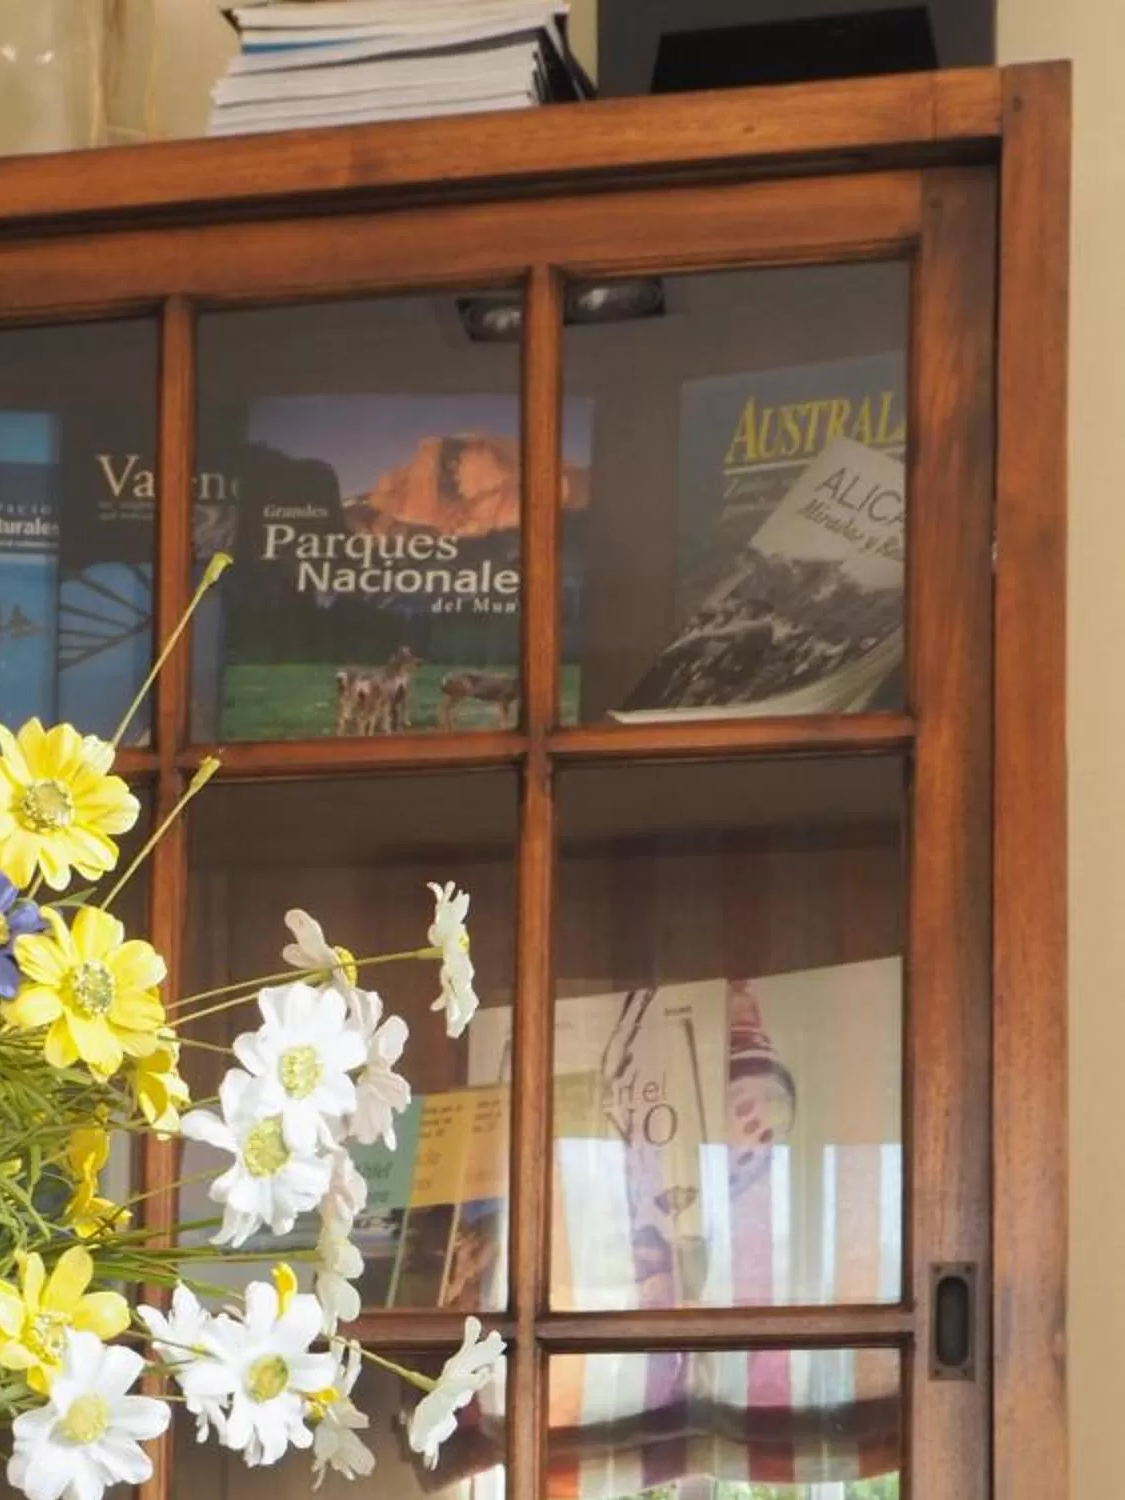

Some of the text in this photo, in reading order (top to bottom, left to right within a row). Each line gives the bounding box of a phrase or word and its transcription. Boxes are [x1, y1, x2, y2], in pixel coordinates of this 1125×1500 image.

[263, 504, 328, 519] Grandes
[813, 466, 905, 528] ALIC
[261, 524, 459, 568] Parques
[297, 560, 520, 593] Nacionale
[431, 599, 518, 613] del Mun
